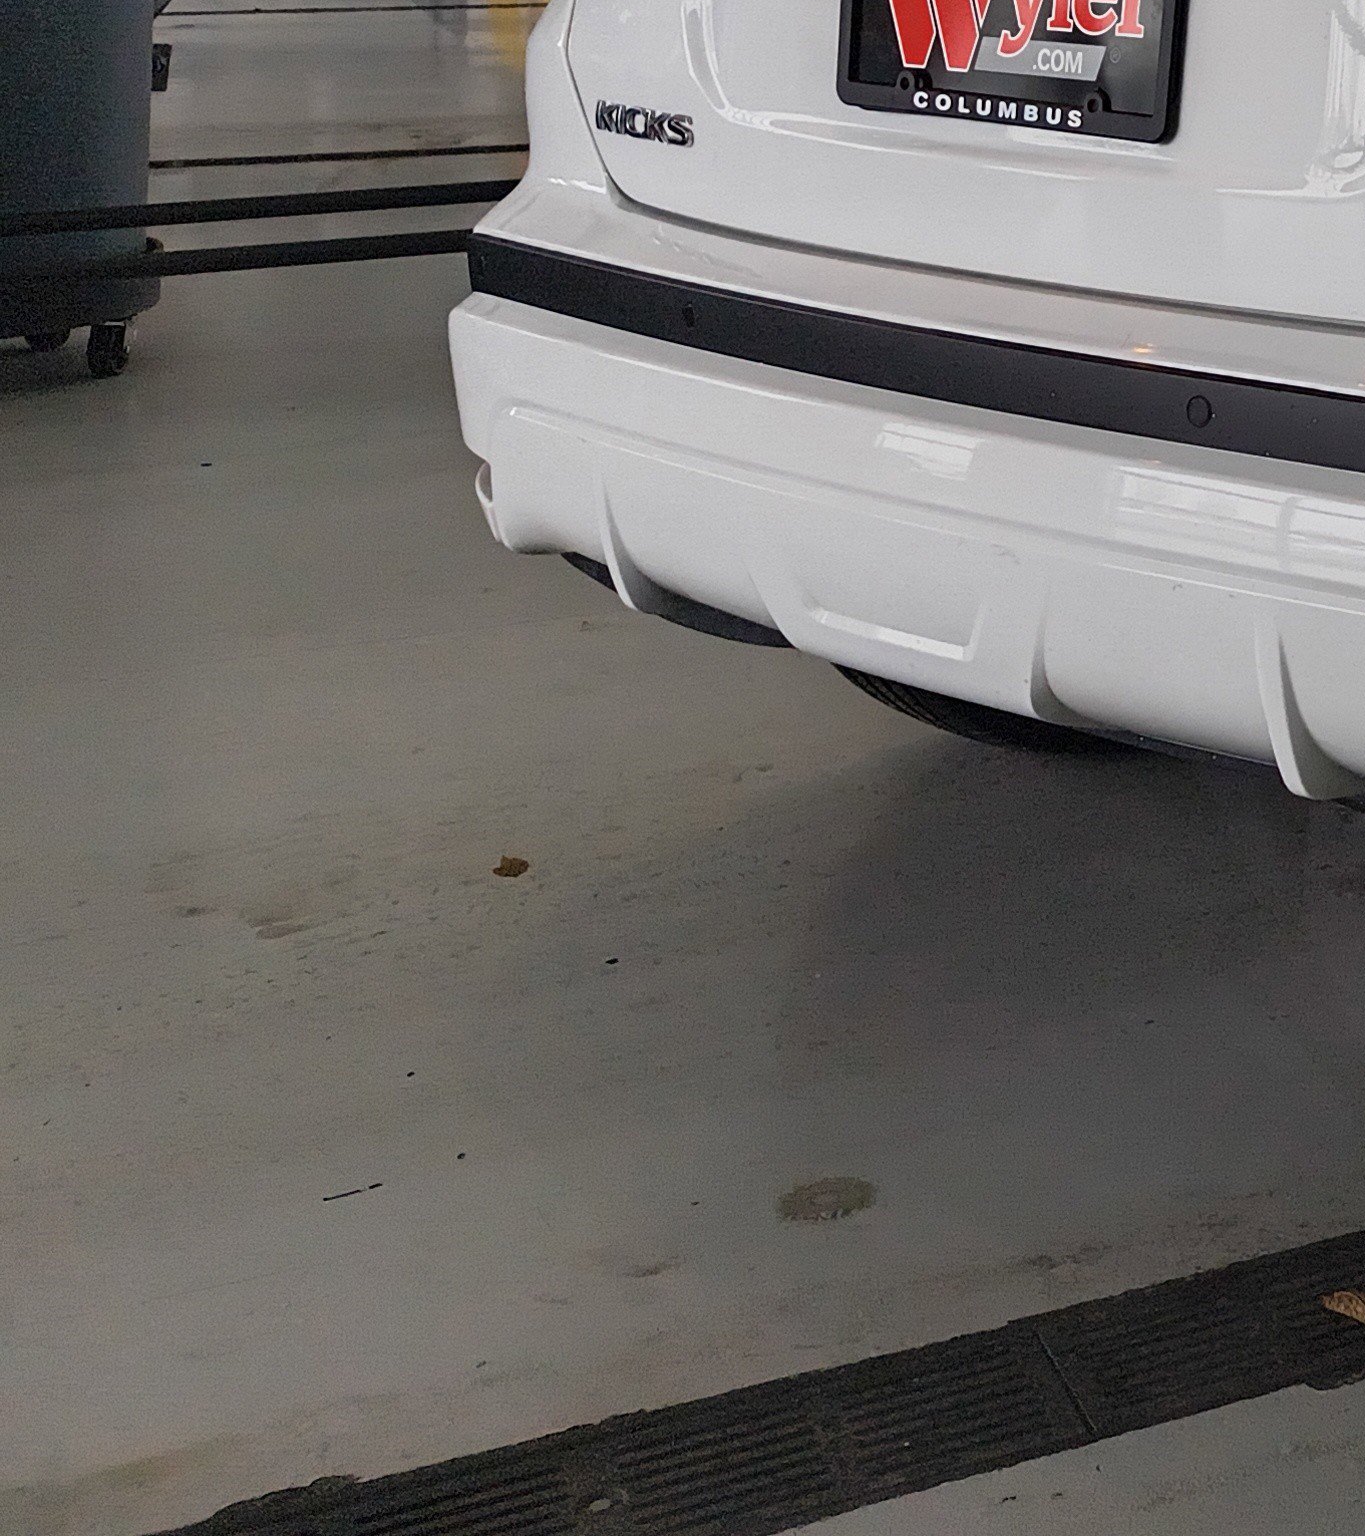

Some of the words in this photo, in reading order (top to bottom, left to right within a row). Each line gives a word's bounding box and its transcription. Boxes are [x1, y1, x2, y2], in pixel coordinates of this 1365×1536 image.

[1032, 48, 1083, 74] .COM
[595, 99, 695, 148] KICKS
[913, 91, 1083, 128] COLUMBUS
